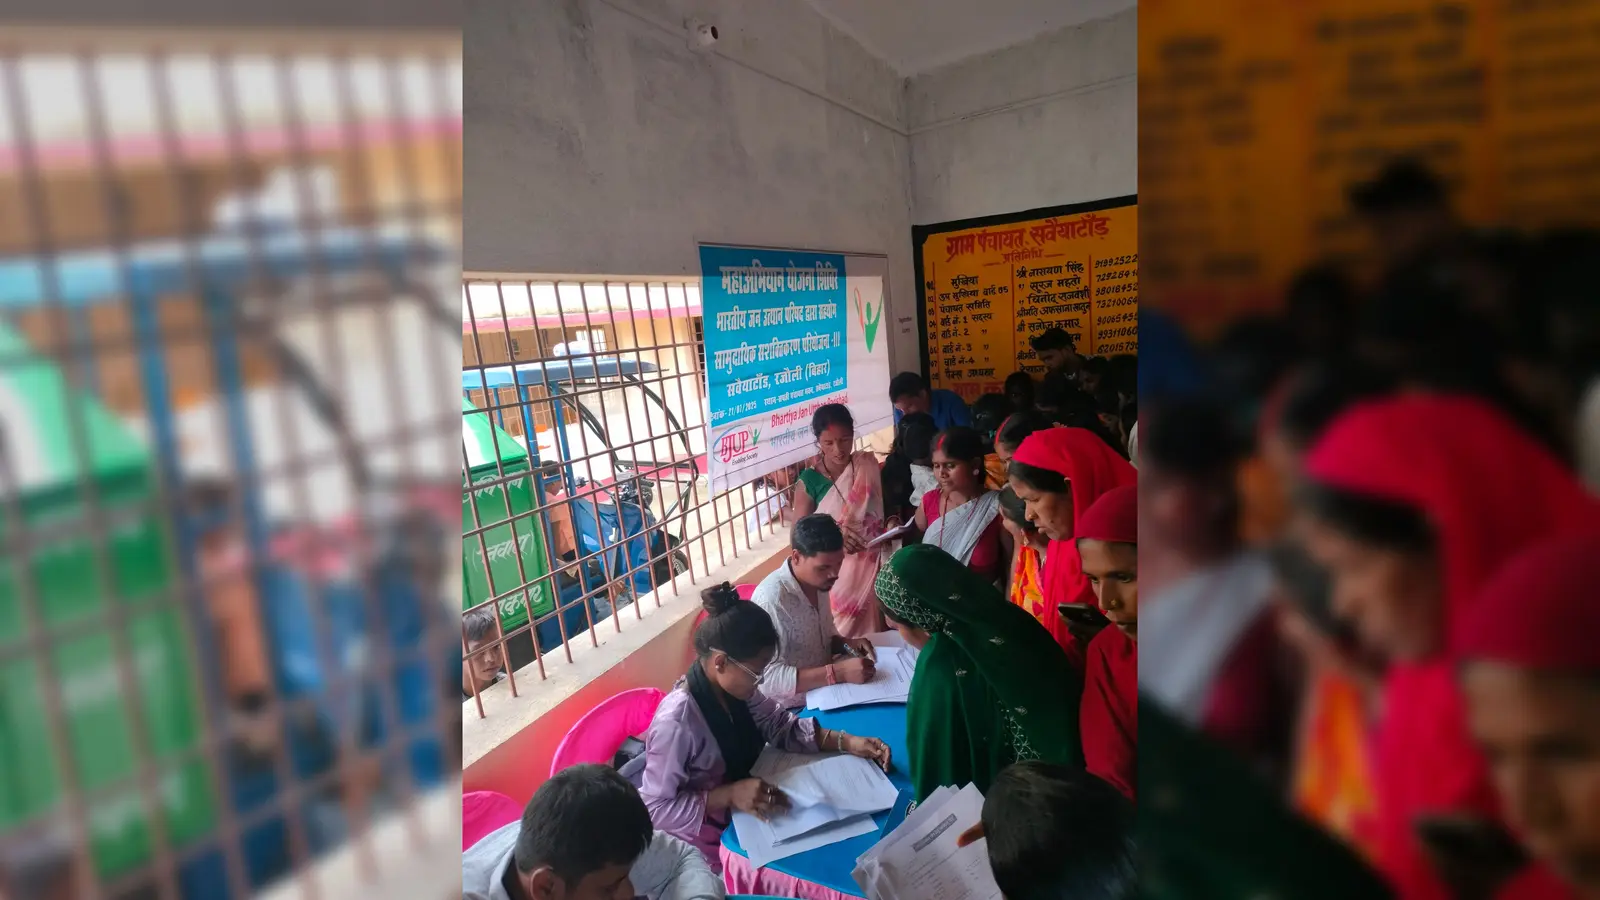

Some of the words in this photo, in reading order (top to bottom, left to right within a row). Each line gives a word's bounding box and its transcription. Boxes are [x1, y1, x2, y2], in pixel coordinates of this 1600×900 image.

[945, 232, 976, 263] ग्राम
[1002, 247, 1045, 264] प्रतिनिधि
[785, 258, 815, 292] योजना
[815, 260, 838, 291] शिविर
[951, 274, 979, 289] मुखिया
[1016, 265, 1027, 278] श्री
[1028, 265, 1063, 277] नारायण
[1065, 260, 1084, 273] सिंह
[952, 288, 979, 301] मुखिया
[1029, 280, 1053, 293] सूरज
[1056, 274, 1081, 288] महतो
[716, 305, 747, 332] भारतीय
[748, 308, 762, 328] जन
[763, 307, 784, 327] उत्थान
[784, 301, 804, 324] परिषद
[805, 304, 818, 321] द्वारा
[818, 299, 837, 320] सहयोग
[939, 303, 963, 314] पंचायत
[965, 298, 991, 311] समिति
[971, 312, 995, 323] सदस्य
[1016, 319, 1026, 332] श्री
[714, 341, 757, 374] सामुदायिक
[801, 331, 830, 354] परियोजना
[774, 365, 803, 386] रजौली
[805, 359, 831, 382] (बिहार)
[771, 410, 798, 428] Bhartiya
[798, 407, 808, 420] Jan
[720, 430, 749, 463] BJUP
[769, 428, 796, 449] भारतीय
